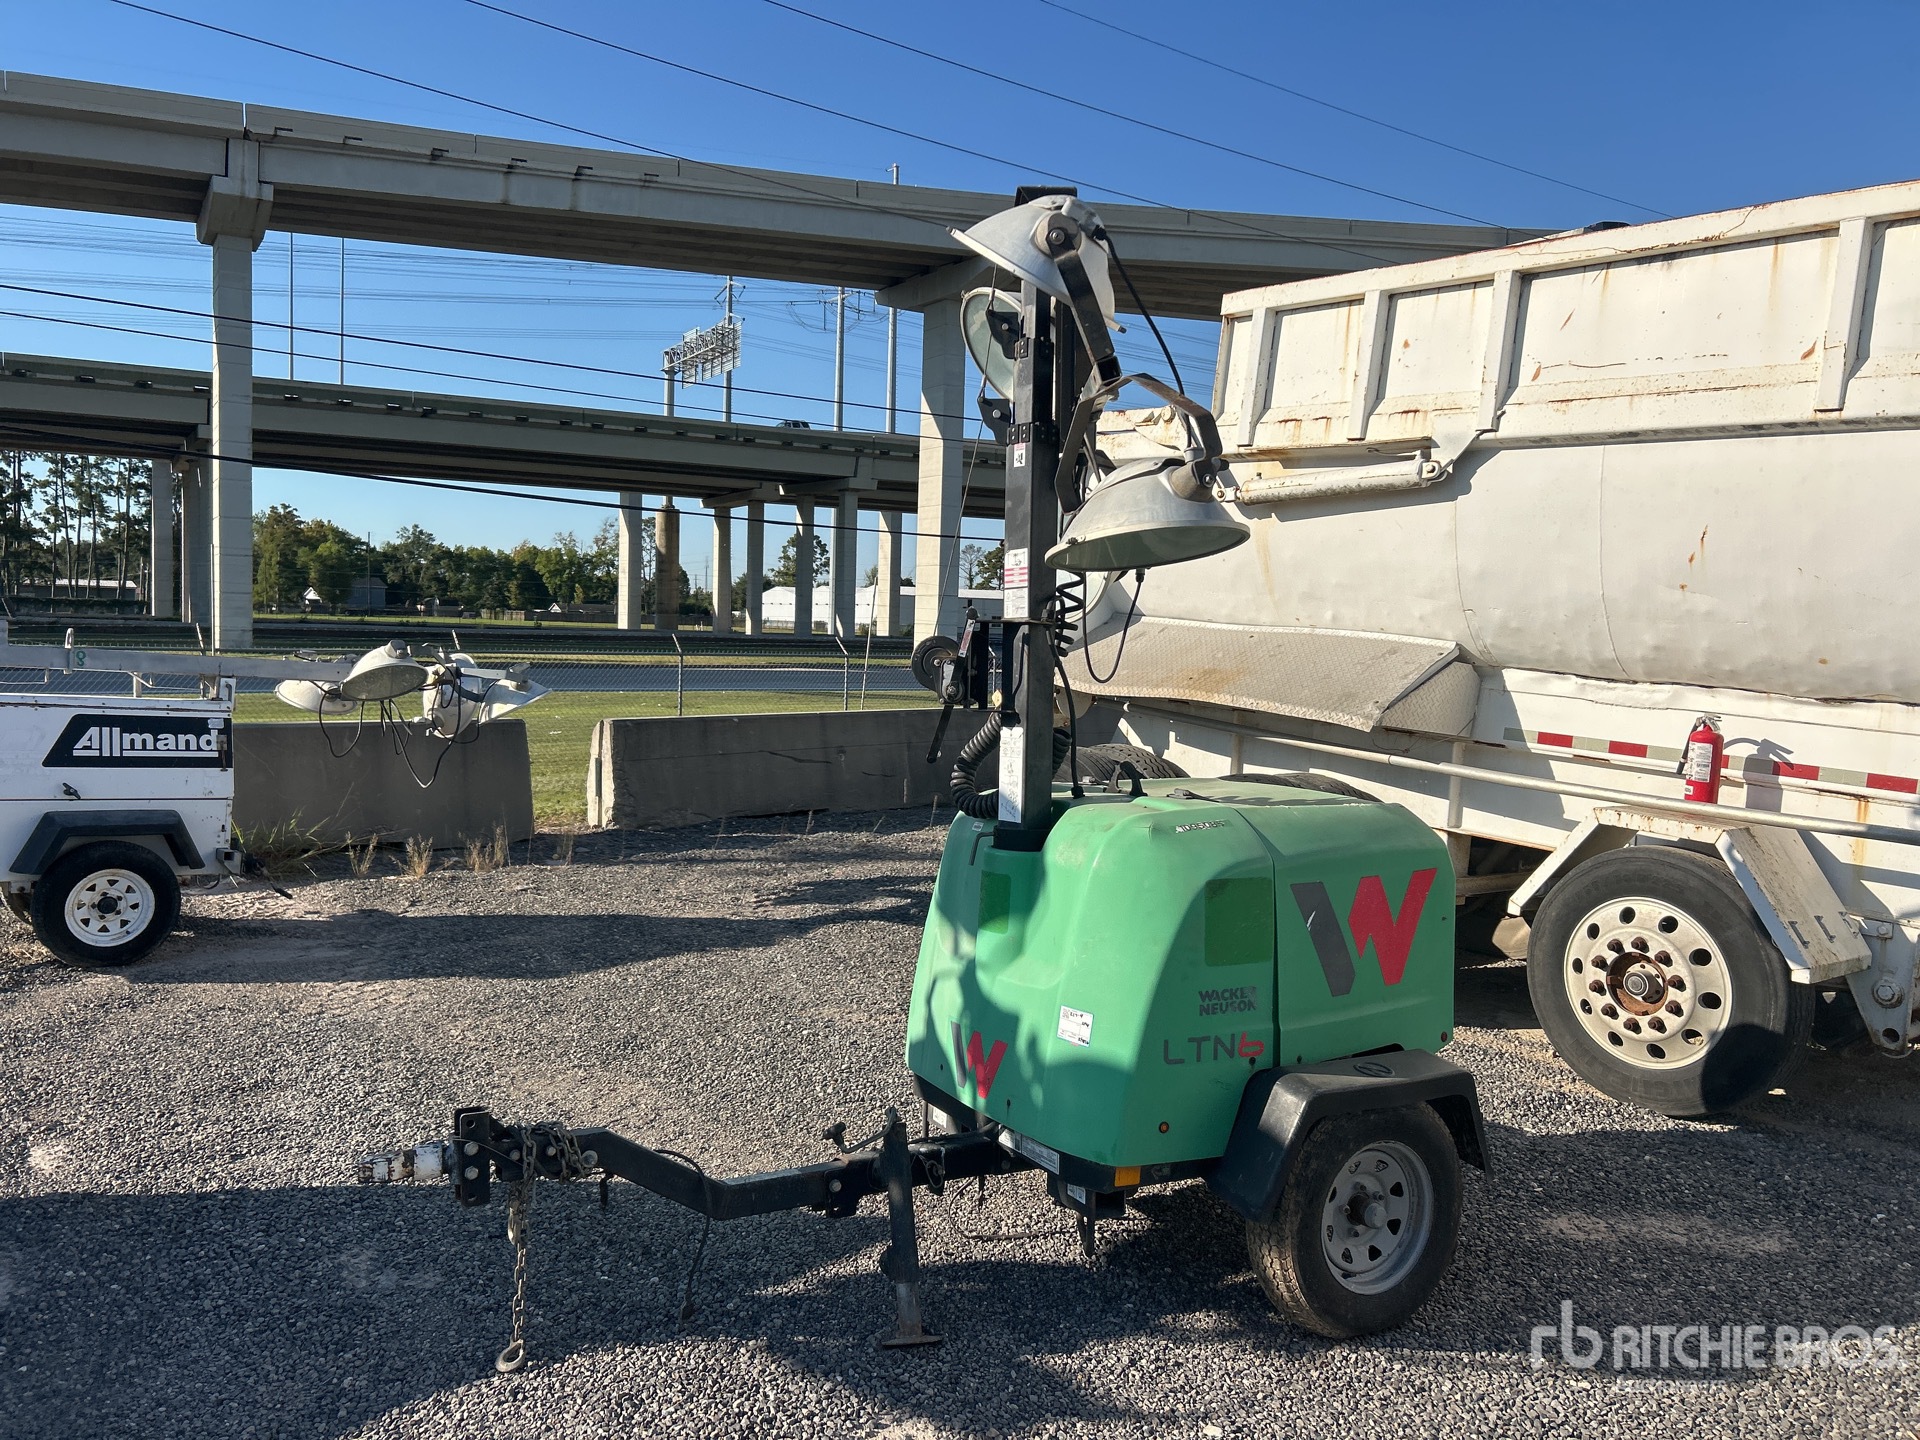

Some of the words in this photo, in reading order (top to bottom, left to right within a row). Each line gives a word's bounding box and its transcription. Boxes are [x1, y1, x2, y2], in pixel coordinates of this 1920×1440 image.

[73, 726, 219, 757] Allmand
[1198, 1000, 1257, 1017] NEUSON
[1163, 1031, 1265, 1065] LTN6
